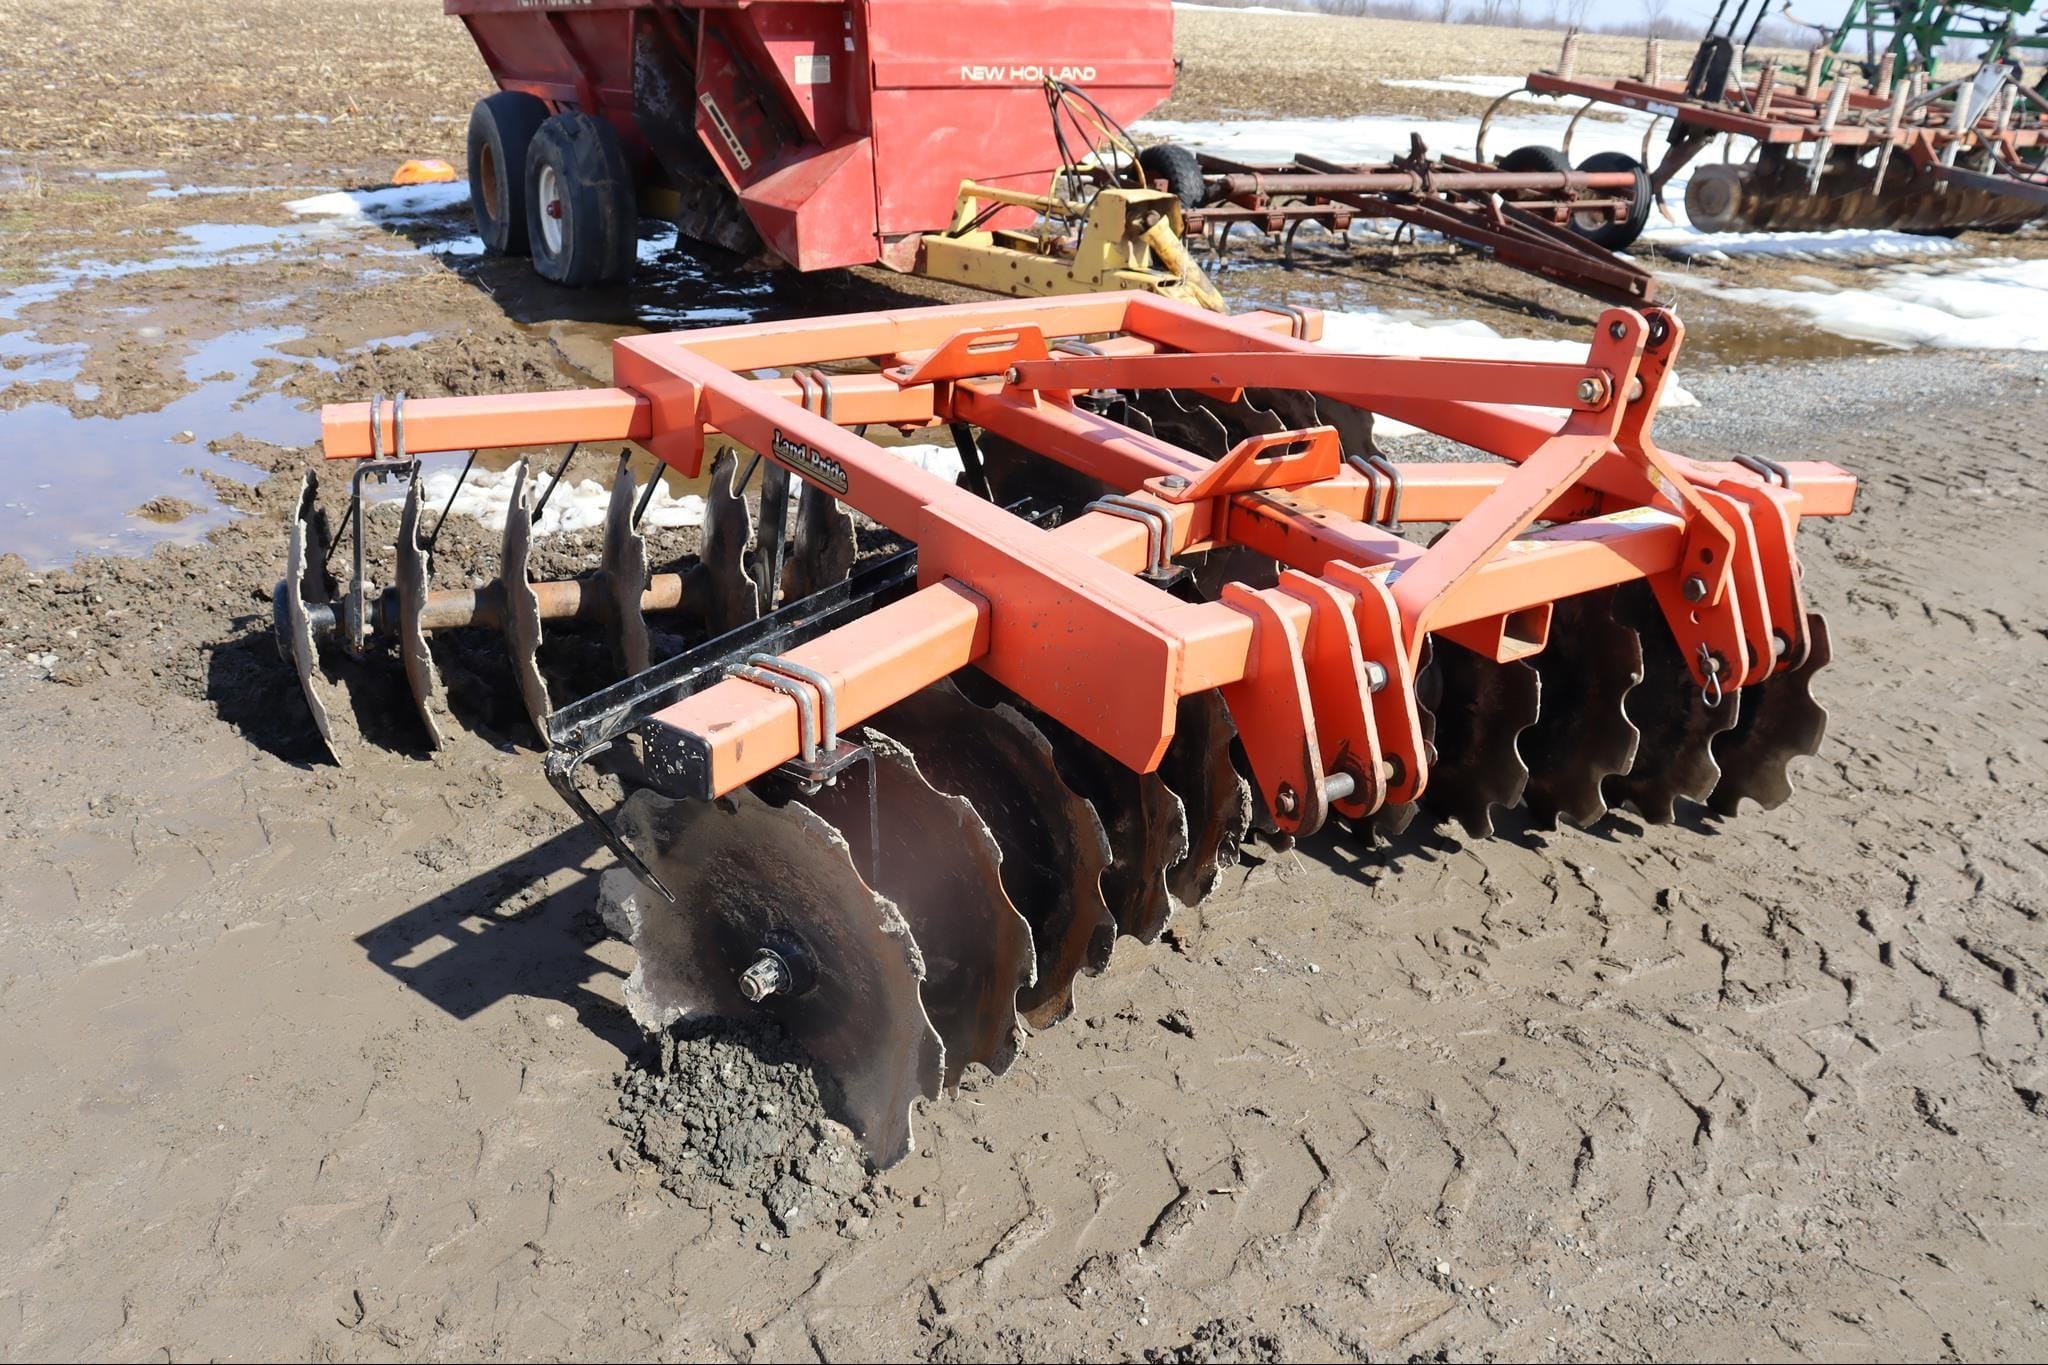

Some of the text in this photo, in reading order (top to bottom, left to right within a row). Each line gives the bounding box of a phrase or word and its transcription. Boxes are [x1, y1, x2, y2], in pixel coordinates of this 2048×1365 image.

[961, 65, 1097, 81] NEW HOLLAND
[774, 430, 847, 482] Land Pride
